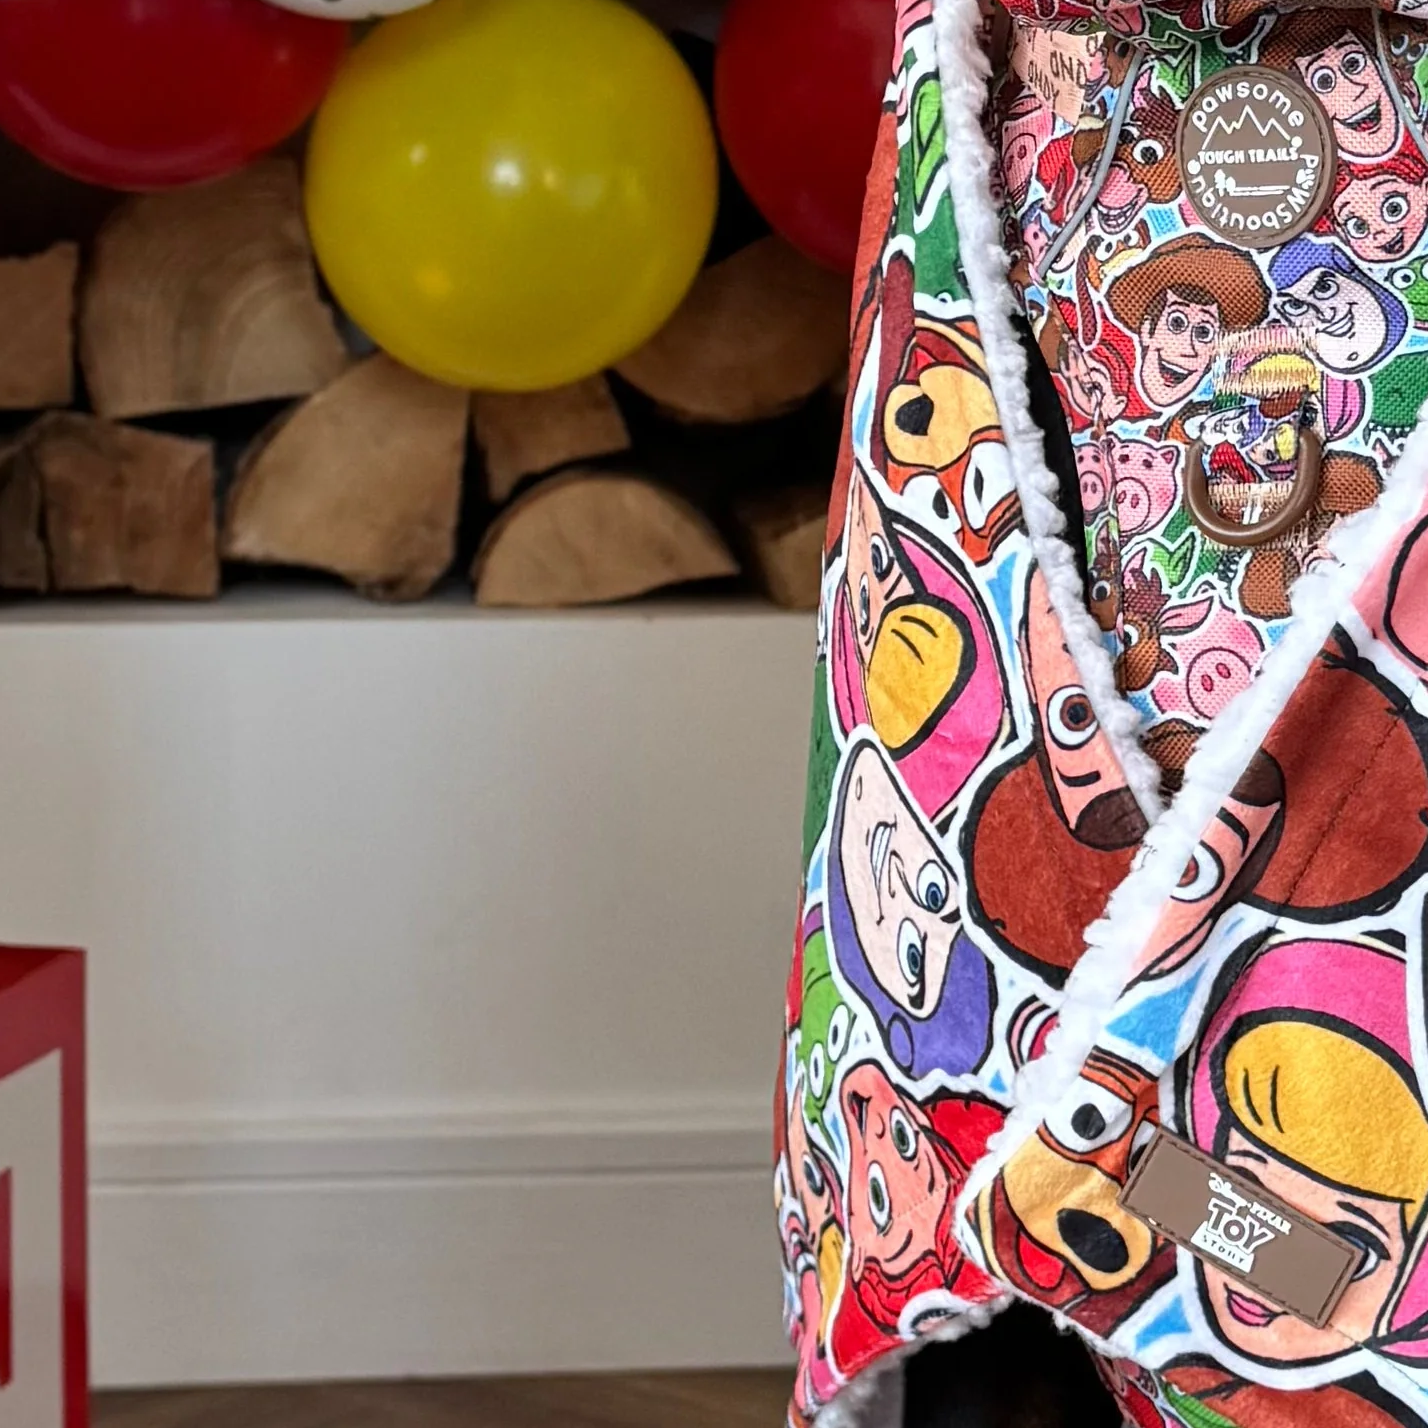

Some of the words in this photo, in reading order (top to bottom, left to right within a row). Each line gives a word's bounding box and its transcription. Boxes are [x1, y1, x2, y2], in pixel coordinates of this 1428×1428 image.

[1191, 81, 1304, 133] pawsome
[1198, 149, 1245, 165] TOUGH
[1247, 146, 1299, 162] TRAILS
[1209, 1200, 1271, 1252] TOY
